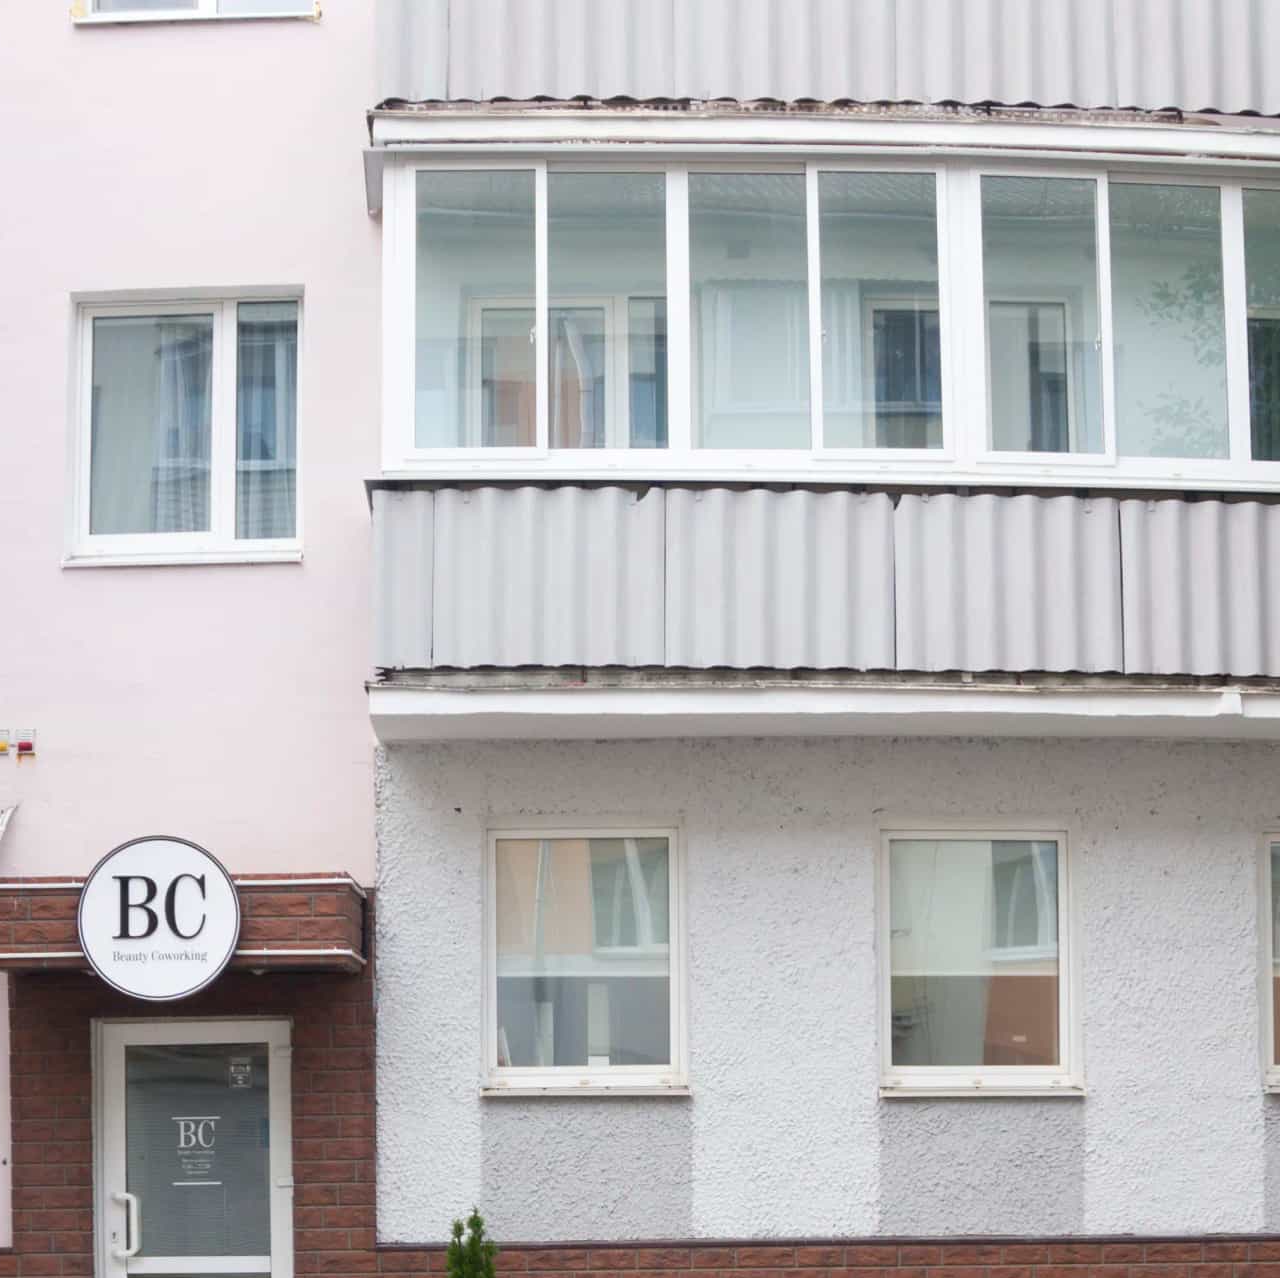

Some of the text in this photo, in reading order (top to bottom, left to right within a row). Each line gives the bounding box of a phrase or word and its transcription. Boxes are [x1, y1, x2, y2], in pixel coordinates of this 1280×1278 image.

[111, 873, 207, 940] BC
[112, 950, 208, 964] Beauty Coworking
[176, 1119, 216, 1148] BC
